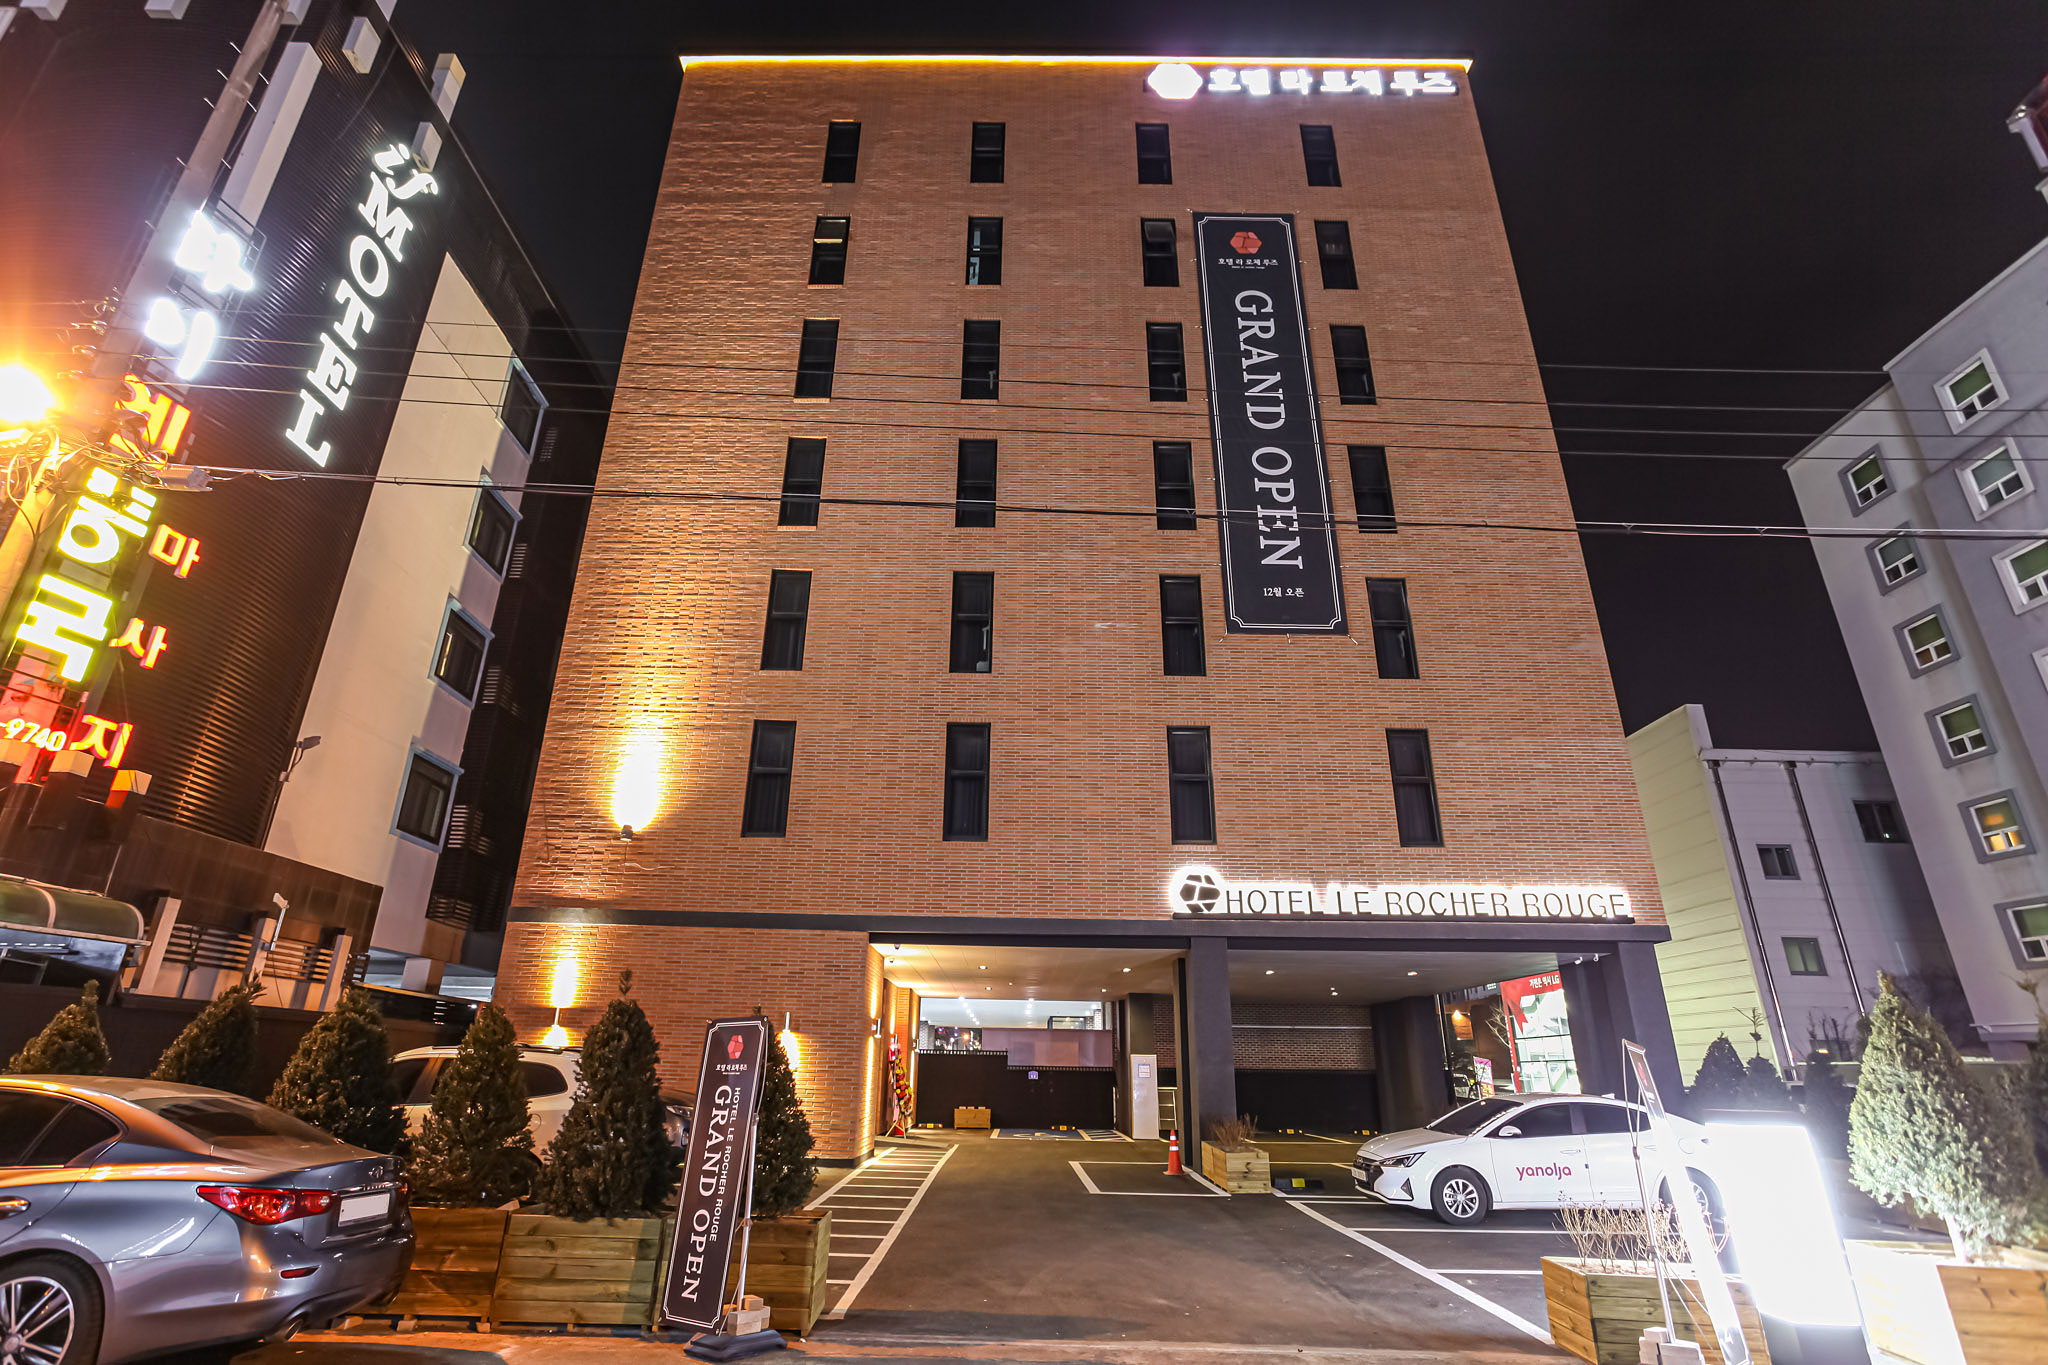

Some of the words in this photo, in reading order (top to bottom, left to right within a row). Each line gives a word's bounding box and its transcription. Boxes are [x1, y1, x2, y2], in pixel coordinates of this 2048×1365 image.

[285, 171, 414, 468] MOTEL
[1234, 290, 1286, 430] GRAND
[1251, 446, 1304, 570] OPEN
[1263, 587, 1283, 598] 12월
[1285, 587, 1305, 598] 오픈
[1226, 888, 1323, 915] HOTEL
[1337, 890, 1373, 916] LE
[1385, 890, 1510, 917] ROCHER
[1523, 892, 1631, 919] ROUGE
[729, 1087, 741, 1124] HOTEL
[699, 1085, 732, 1197] GRAND
[726, 1127, 735, 1142] LE
[717, 1145, 732, 1195] ROCHER
[1515, 1162, 1572, 1181] yanolja
[709, 1198, 723, 1242] ROUGE
[681, 1209, 710, 1303] OPEN
